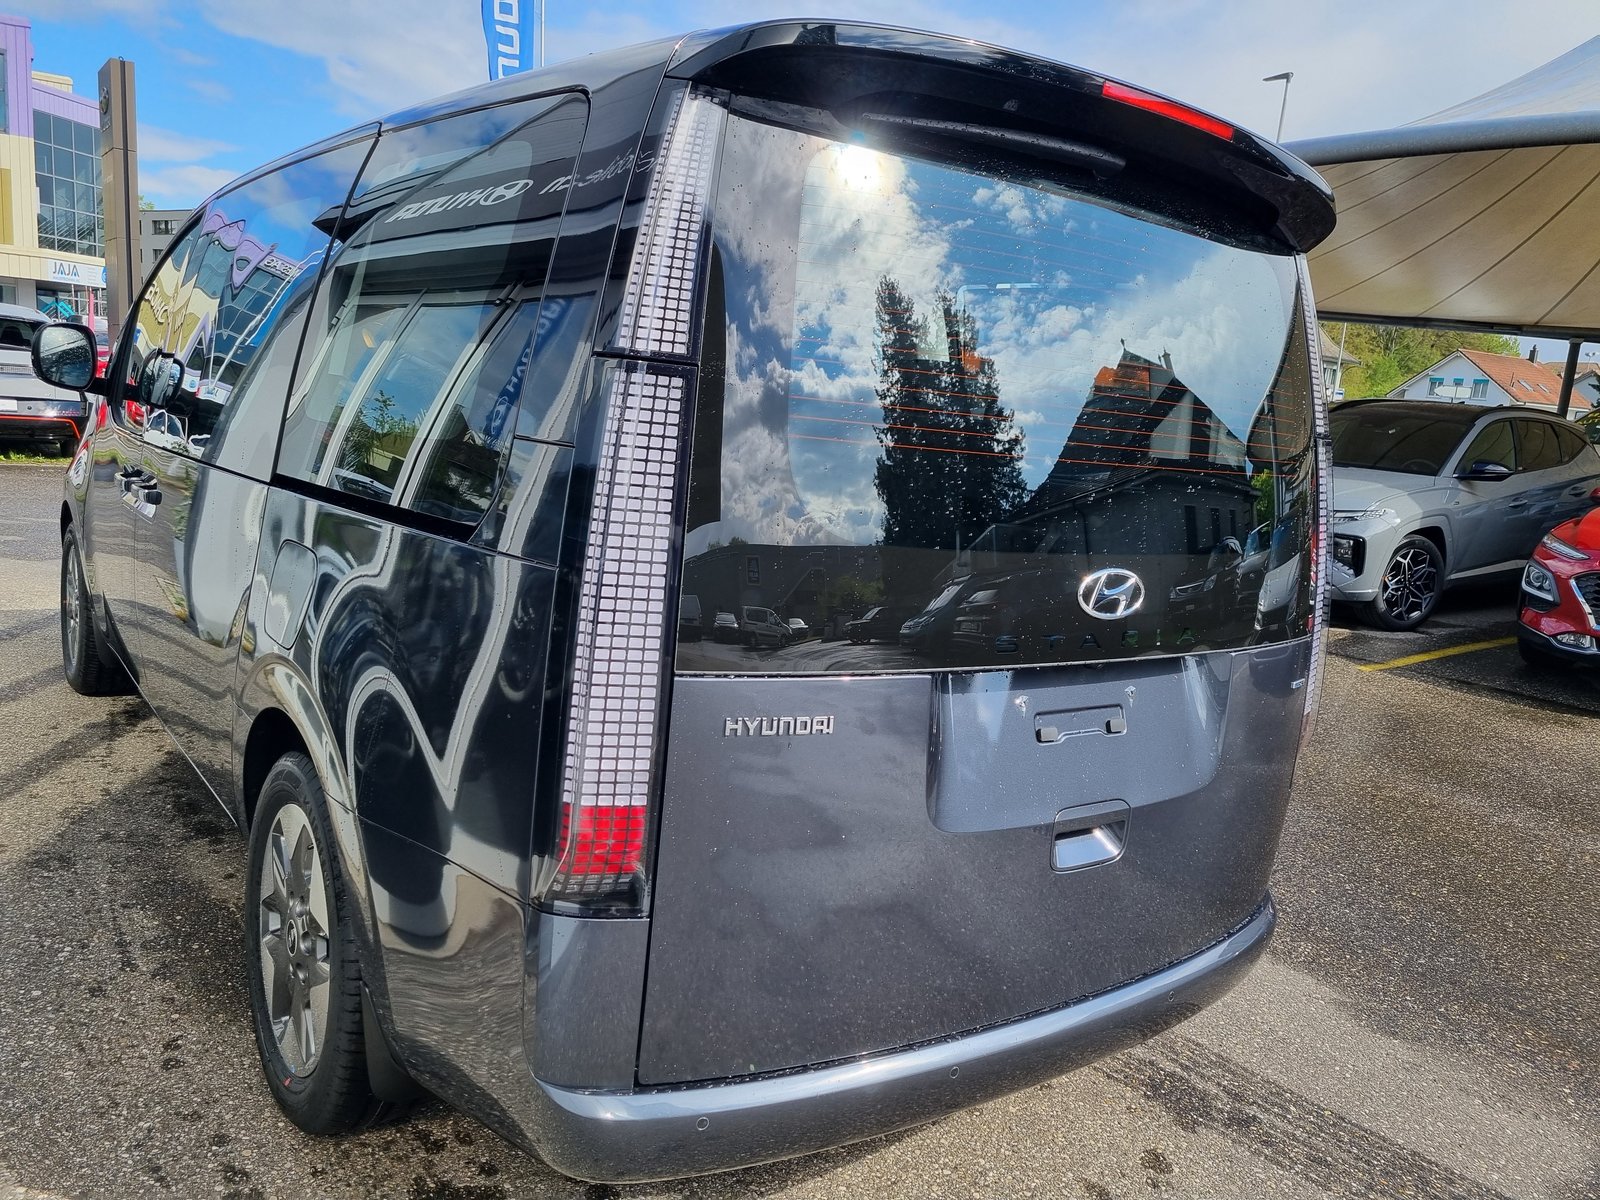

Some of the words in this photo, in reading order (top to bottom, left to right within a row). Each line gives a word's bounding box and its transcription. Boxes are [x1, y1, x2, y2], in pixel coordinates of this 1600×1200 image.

[53, 261, 80, 277] JAJA
[995, 627, 1196, 654] STARIA
[725, 716, 834, 736] HYUNDAI
